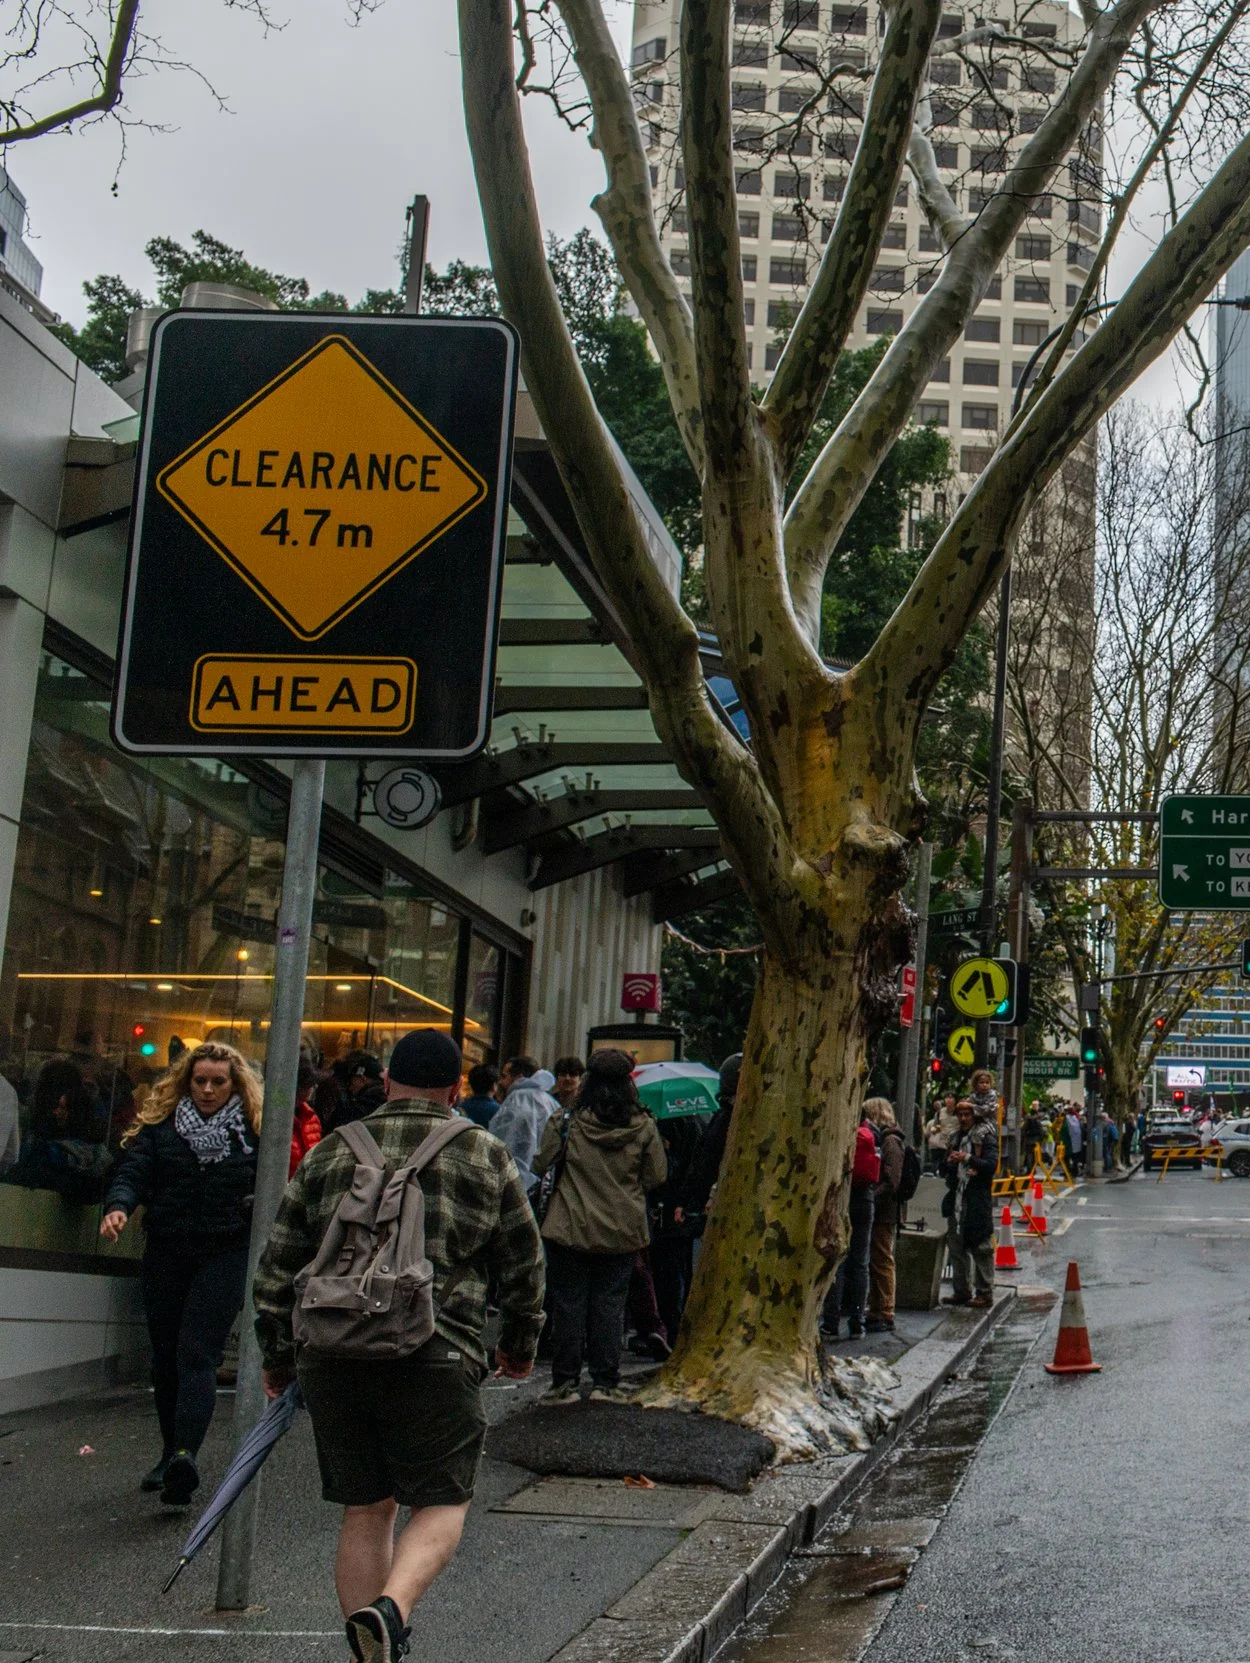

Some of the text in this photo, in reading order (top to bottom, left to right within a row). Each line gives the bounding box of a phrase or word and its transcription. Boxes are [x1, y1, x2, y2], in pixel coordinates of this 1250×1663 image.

[205, 448, 443, 493] CLEARANCE
[205, 675, 403, 714] AHEAD
[1206, 854, 1225, 866] TO
[1206, 881, 1225, 893] TO
[942, 911, 977, 926] LANG ST
[1024, 1067, 1054, 1075] RBOUR
[666, 1096, 708, 1108] LOVE
